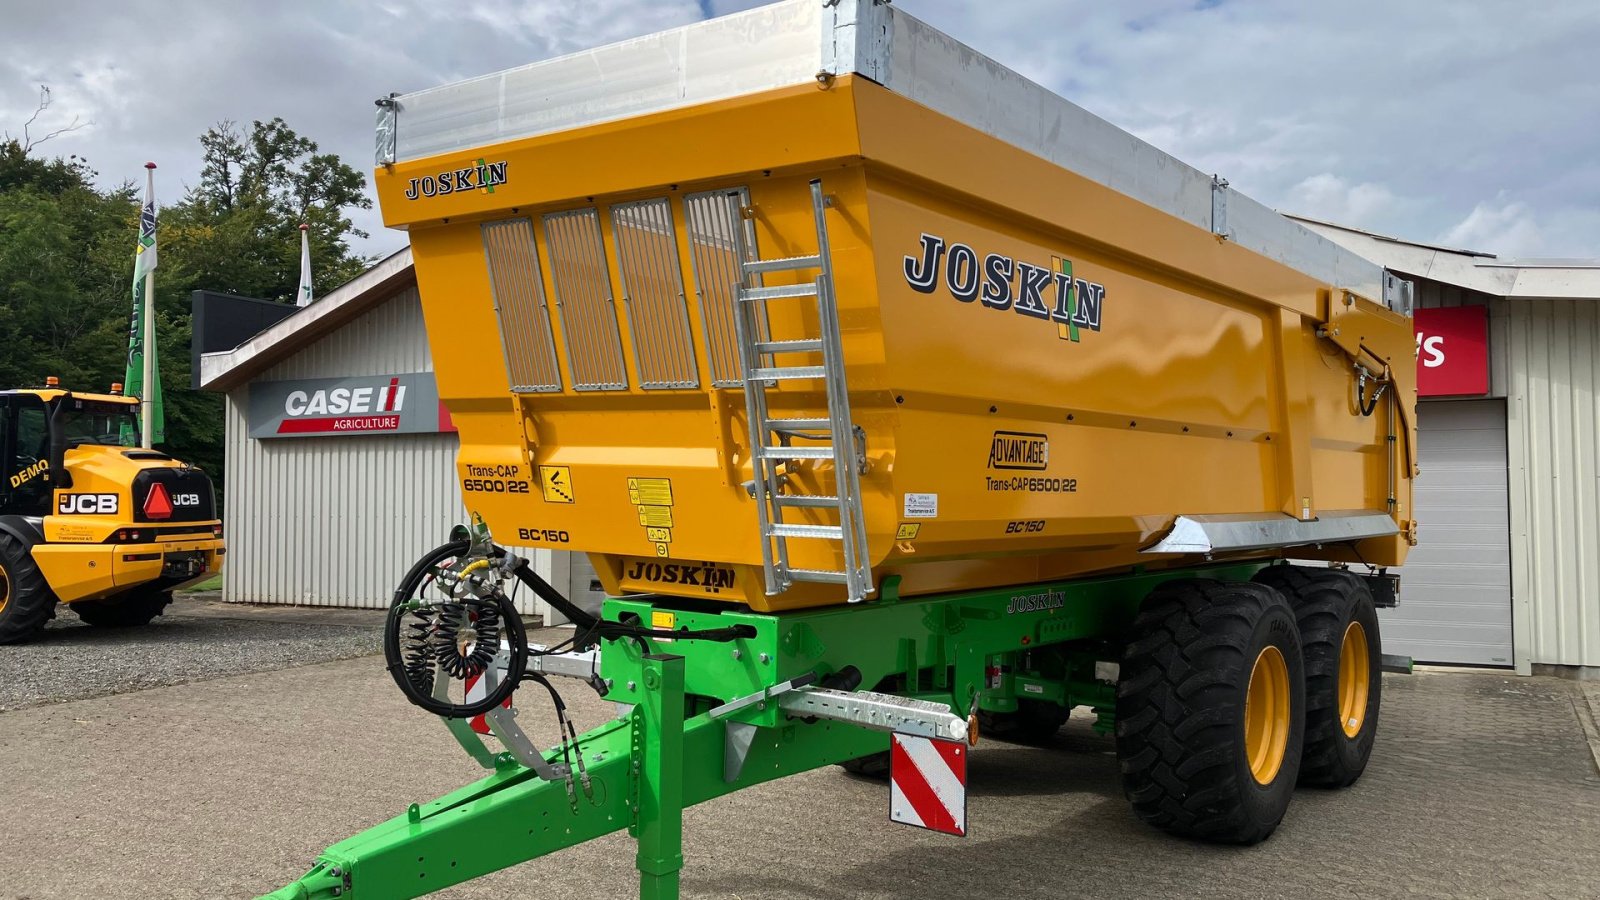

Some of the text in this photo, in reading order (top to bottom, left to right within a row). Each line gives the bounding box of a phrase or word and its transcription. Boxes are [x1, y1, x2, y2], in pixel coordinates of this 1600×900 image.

[405, 160, 508, 200] JOSKIN
[904, 232, 1106, 333] JOSKIN
[285, 387, 373, 416] CASE
[333, 417, 397, 430] AGRICULTURE
[987, 437, 1044, 469] ADVANTAGE
[10, 459, 49, 488] DEMO
[466, 464, 519, 478] Trans-CAP
[59, 494, 118, 514] JCB
[172, 494, 200, 506] JCB
[518, 528, 570, 543] BC150
[1005, 520, 1046, 534] BC150
[629, 562, 735, 592] JOSKIN
[1007, 590, 1066, 614] JOSKIN
